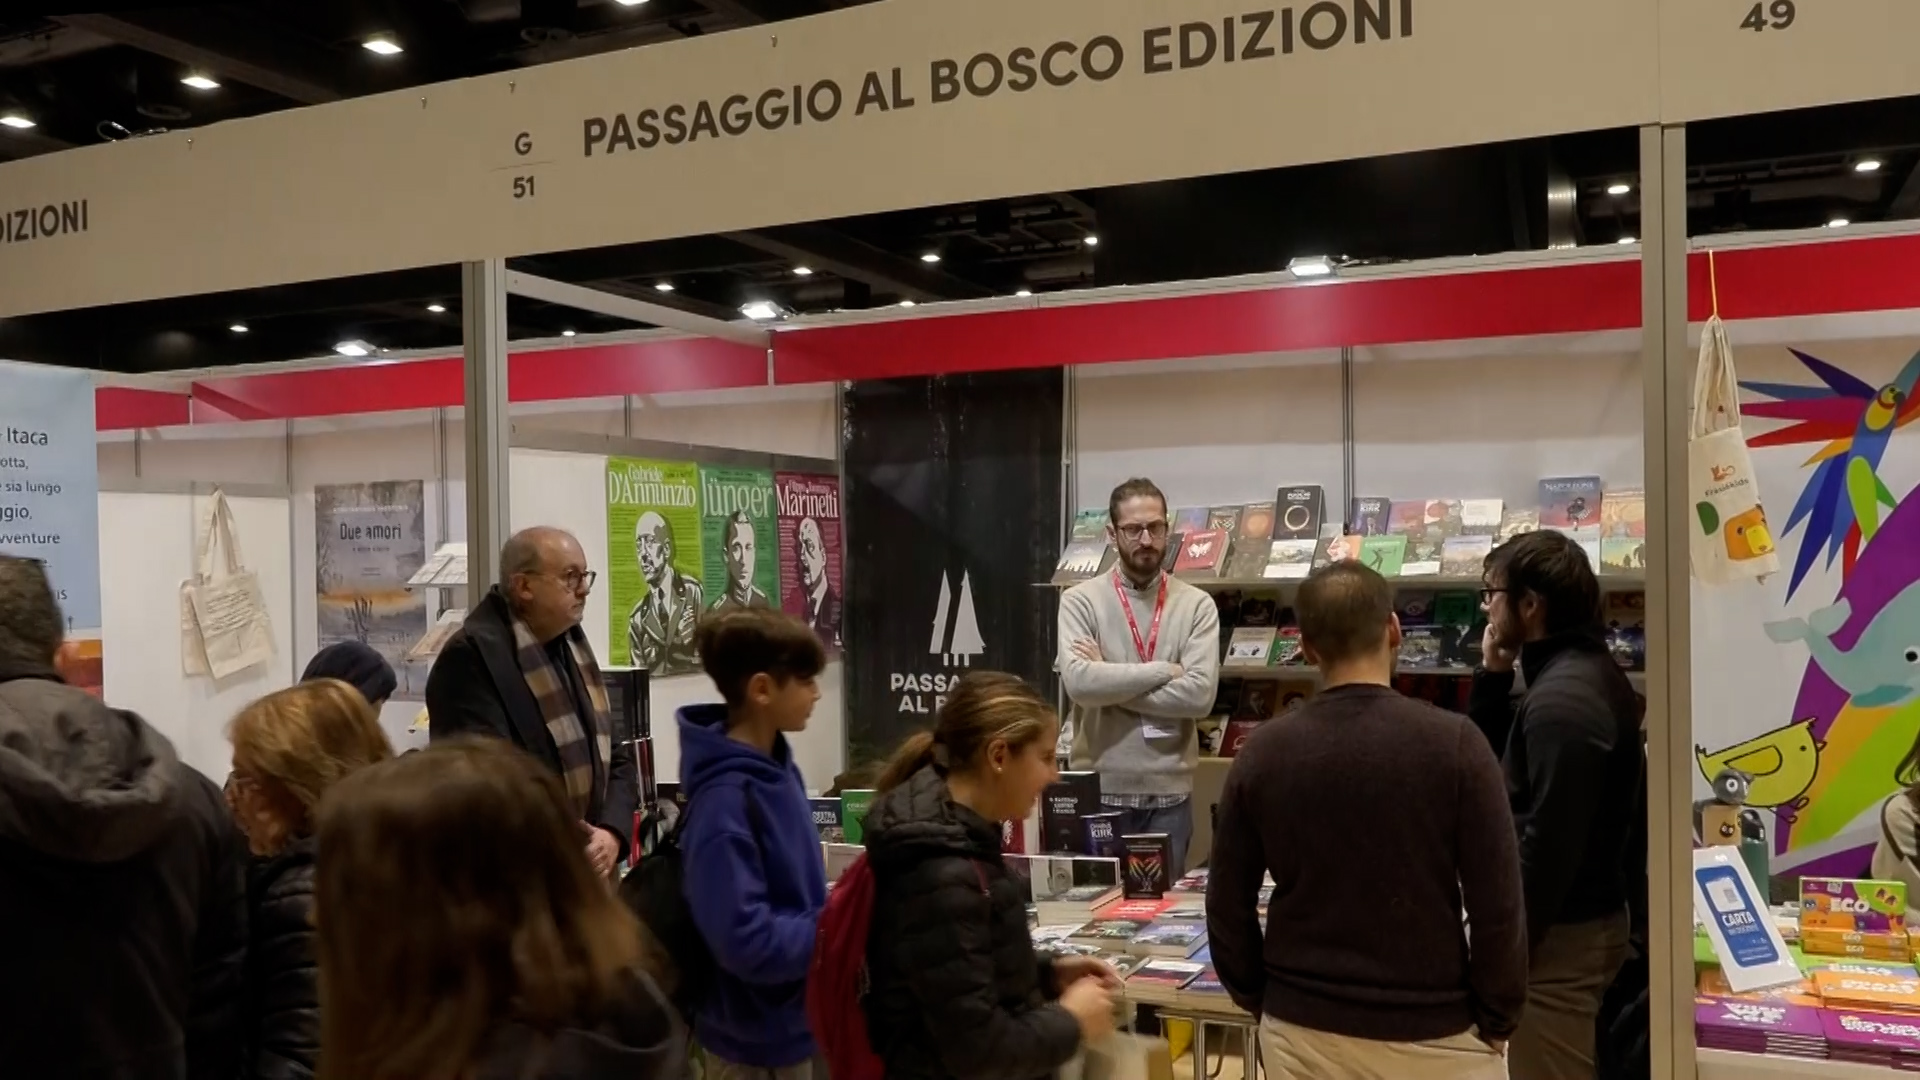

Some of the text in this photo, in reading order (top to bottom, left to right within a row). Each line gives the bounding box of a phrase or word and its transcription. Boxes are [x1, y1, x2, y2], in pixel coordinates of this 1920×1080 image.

[1739, 0, 1796, 32] 49
[583, 0, 1414, 158] PASSAGGIO AL BOSCO EDIZIONI
[514, 131, 533, 156] G
[513, 175, 535, 199] 51
[7, 427, 49, 446] Itaca
[5, 480, 62, 496] sia lungo
[609, 471, 697, 508] D'Annunzio
[699, 469, 773, 518] Jünger
[775, 484, 839, 518] Marinetti
[340, 522, 402, 540] Due amori
[898, 695, 929, 714] AL
[1830, 896, 1871, 914] ECO
